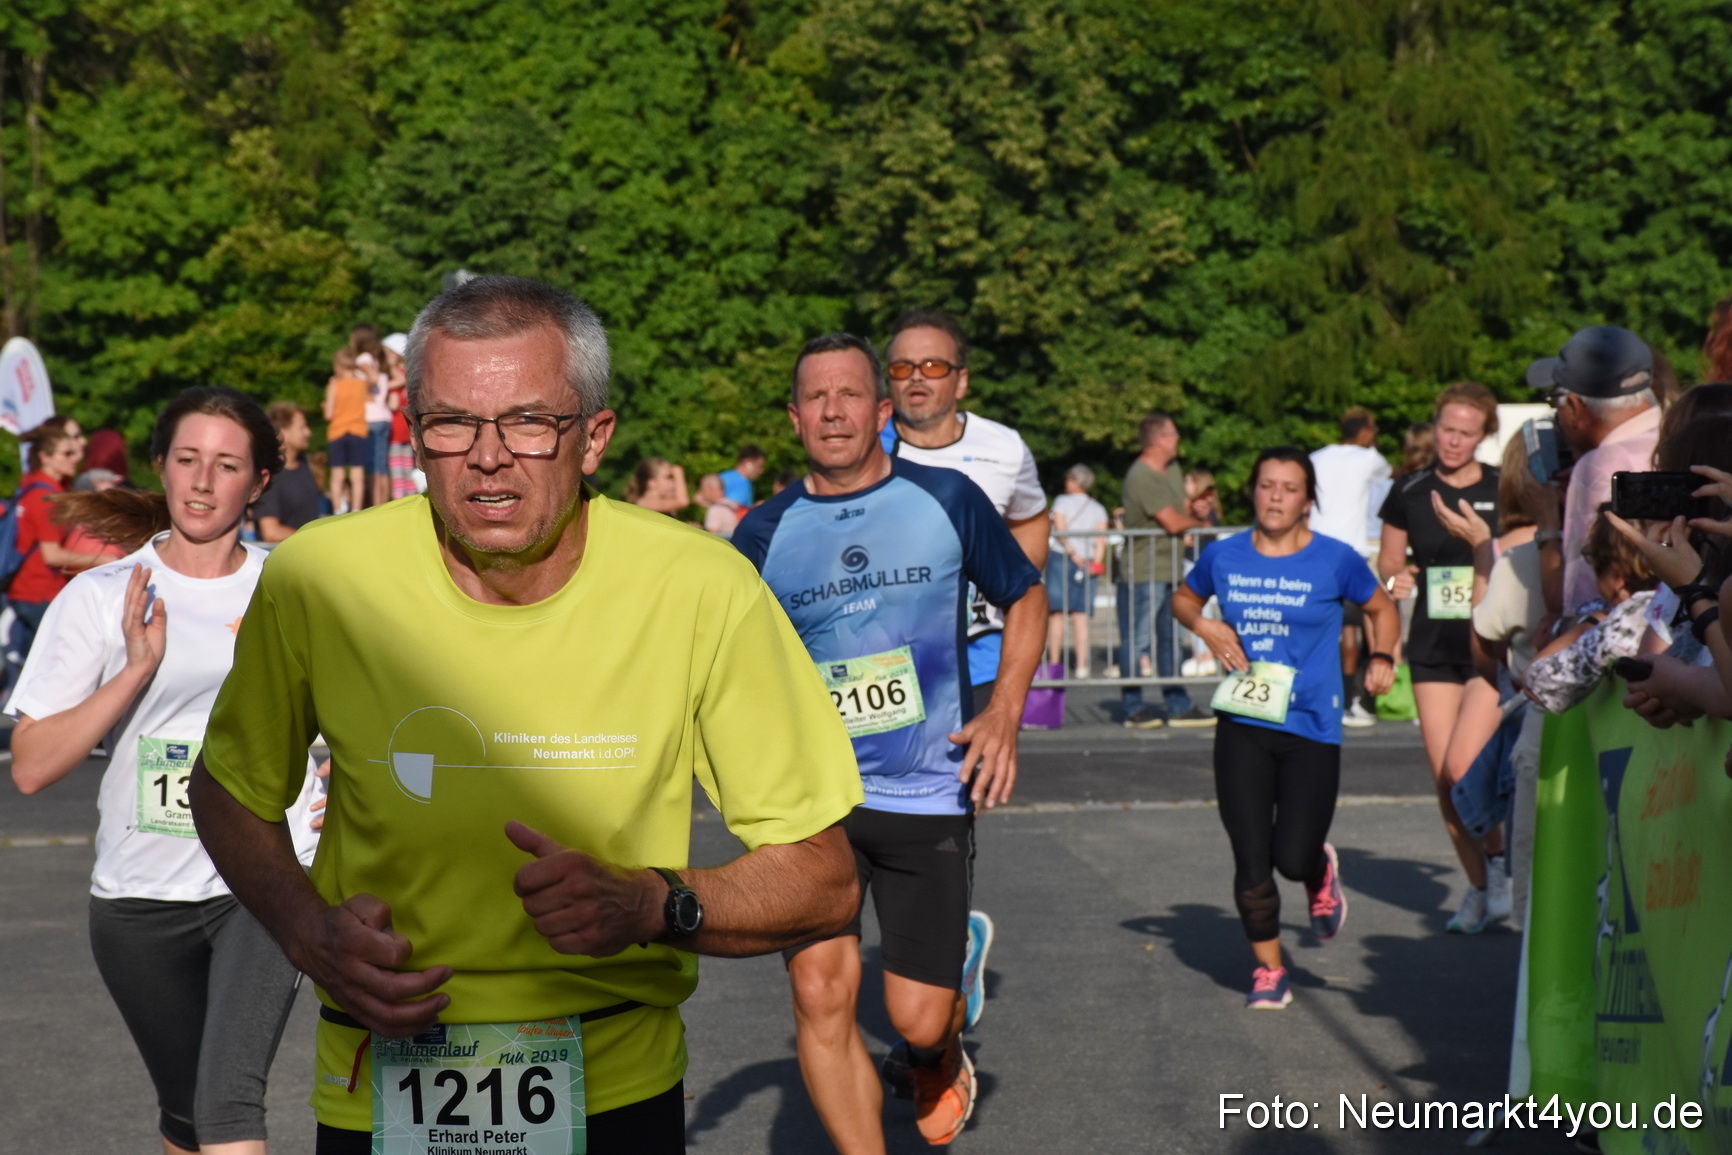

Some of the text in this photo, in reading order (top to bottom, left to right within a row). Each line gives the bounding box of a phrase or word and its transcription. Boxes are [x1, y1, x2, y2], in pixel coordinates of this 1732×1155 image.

[790, 566, 932, 610] SCHABMÜLLER
[1228, 573, 1312, 593] Wenn es beim
[842, 598, 877, 615] TEAM
[1227, 589, 1307, 608] Hausverkauf
[1243, 606, 1283, 623] richtig
[1236, 621, 1290, 637] LAUFEN
[830, 678, 906, 716] 2106
[494, 732, 638, 744] Kliniken des Landkreises
[533, 748, 595, 759] Neumarkt
[517, 1024, 543, 1036] laufen
[398, 1040, 480, 1057] firmenlauf
[530, 1049, 568, 1063] 2019
[399, 1065, 556, 1126] 1216
[428, 1129, 527, 1144] Erhard Peter
[427, 1146, 527, 1155] Klinikum Neumarkt
